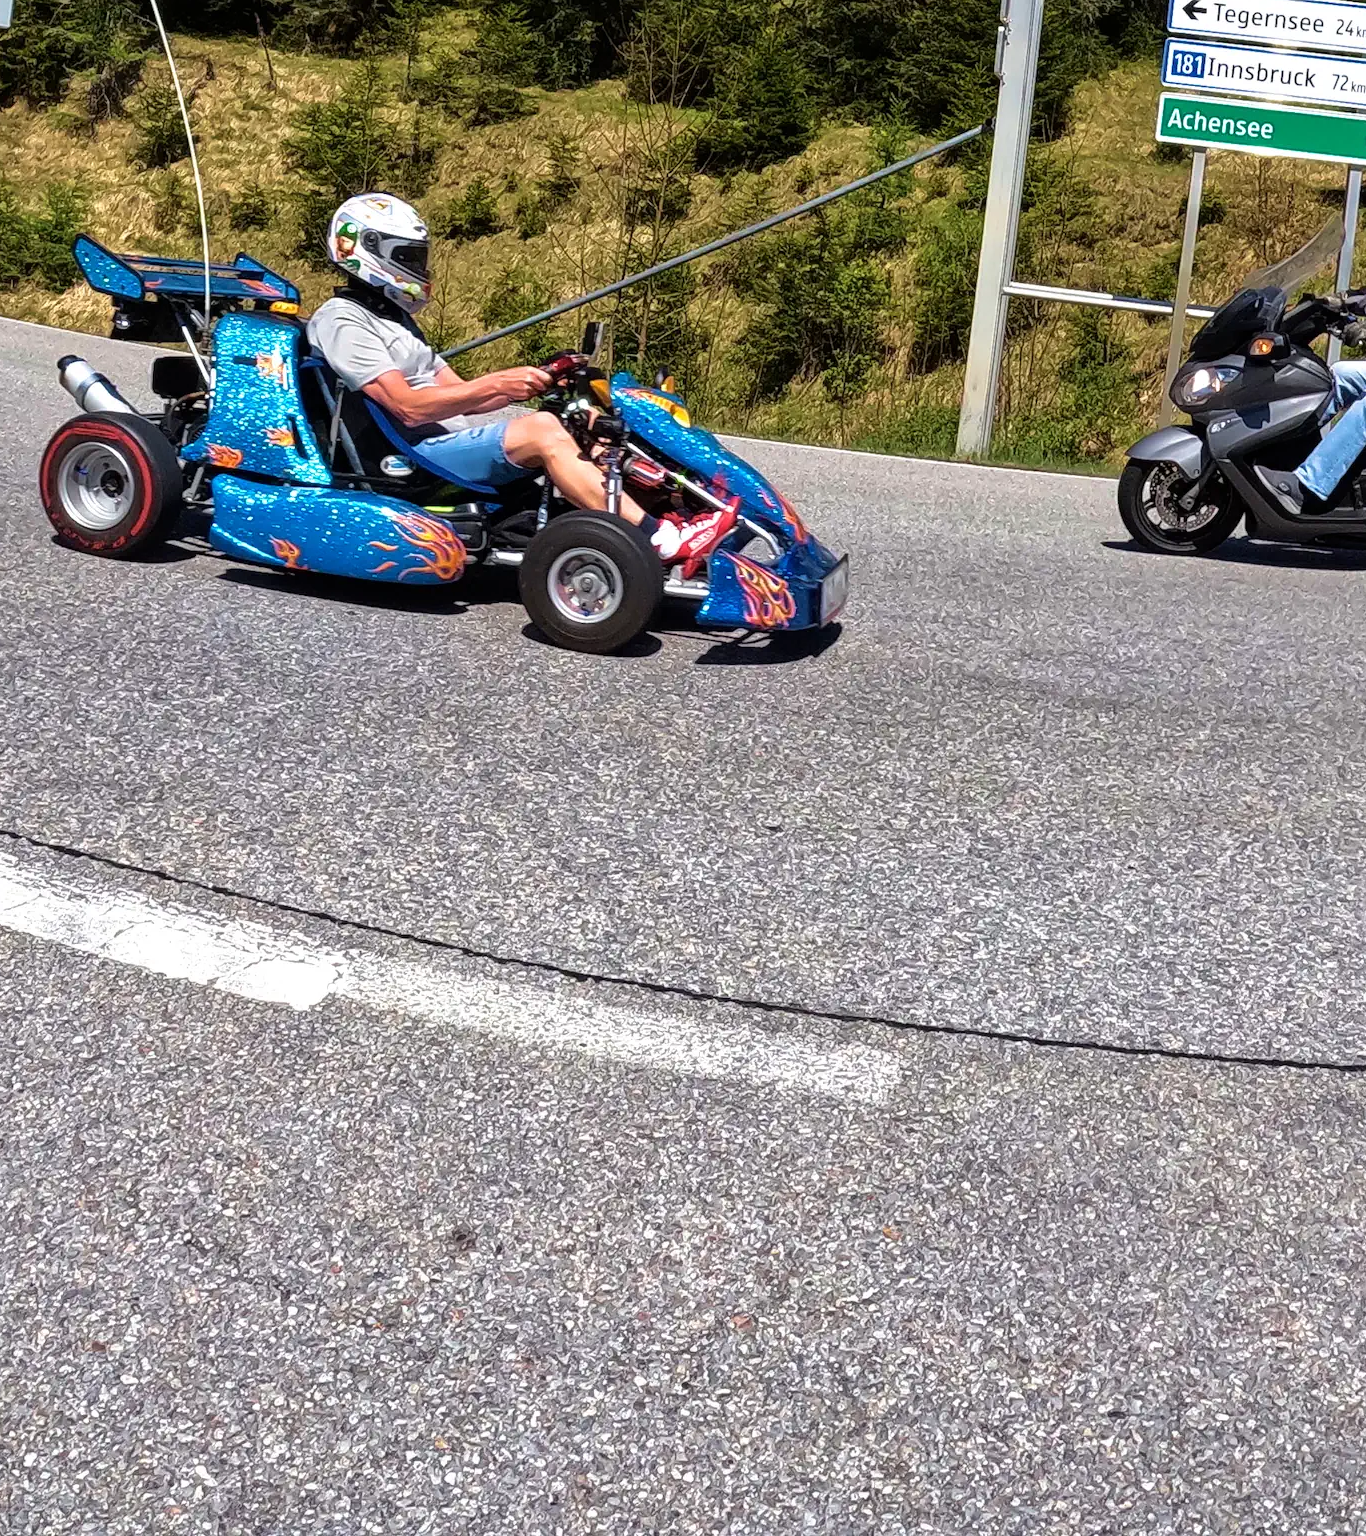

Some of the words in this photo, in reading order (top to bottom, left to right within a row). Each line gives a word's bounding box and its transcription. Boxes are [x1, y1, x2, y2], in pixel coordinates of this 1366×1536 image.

[1213, 2, 1324, 34] Tegernsee
[1174, 52, 1205, 76] 181
[1207, 57, 1316, 89] Innsbruck
[1168, 107, 1274, 139] Achensee
